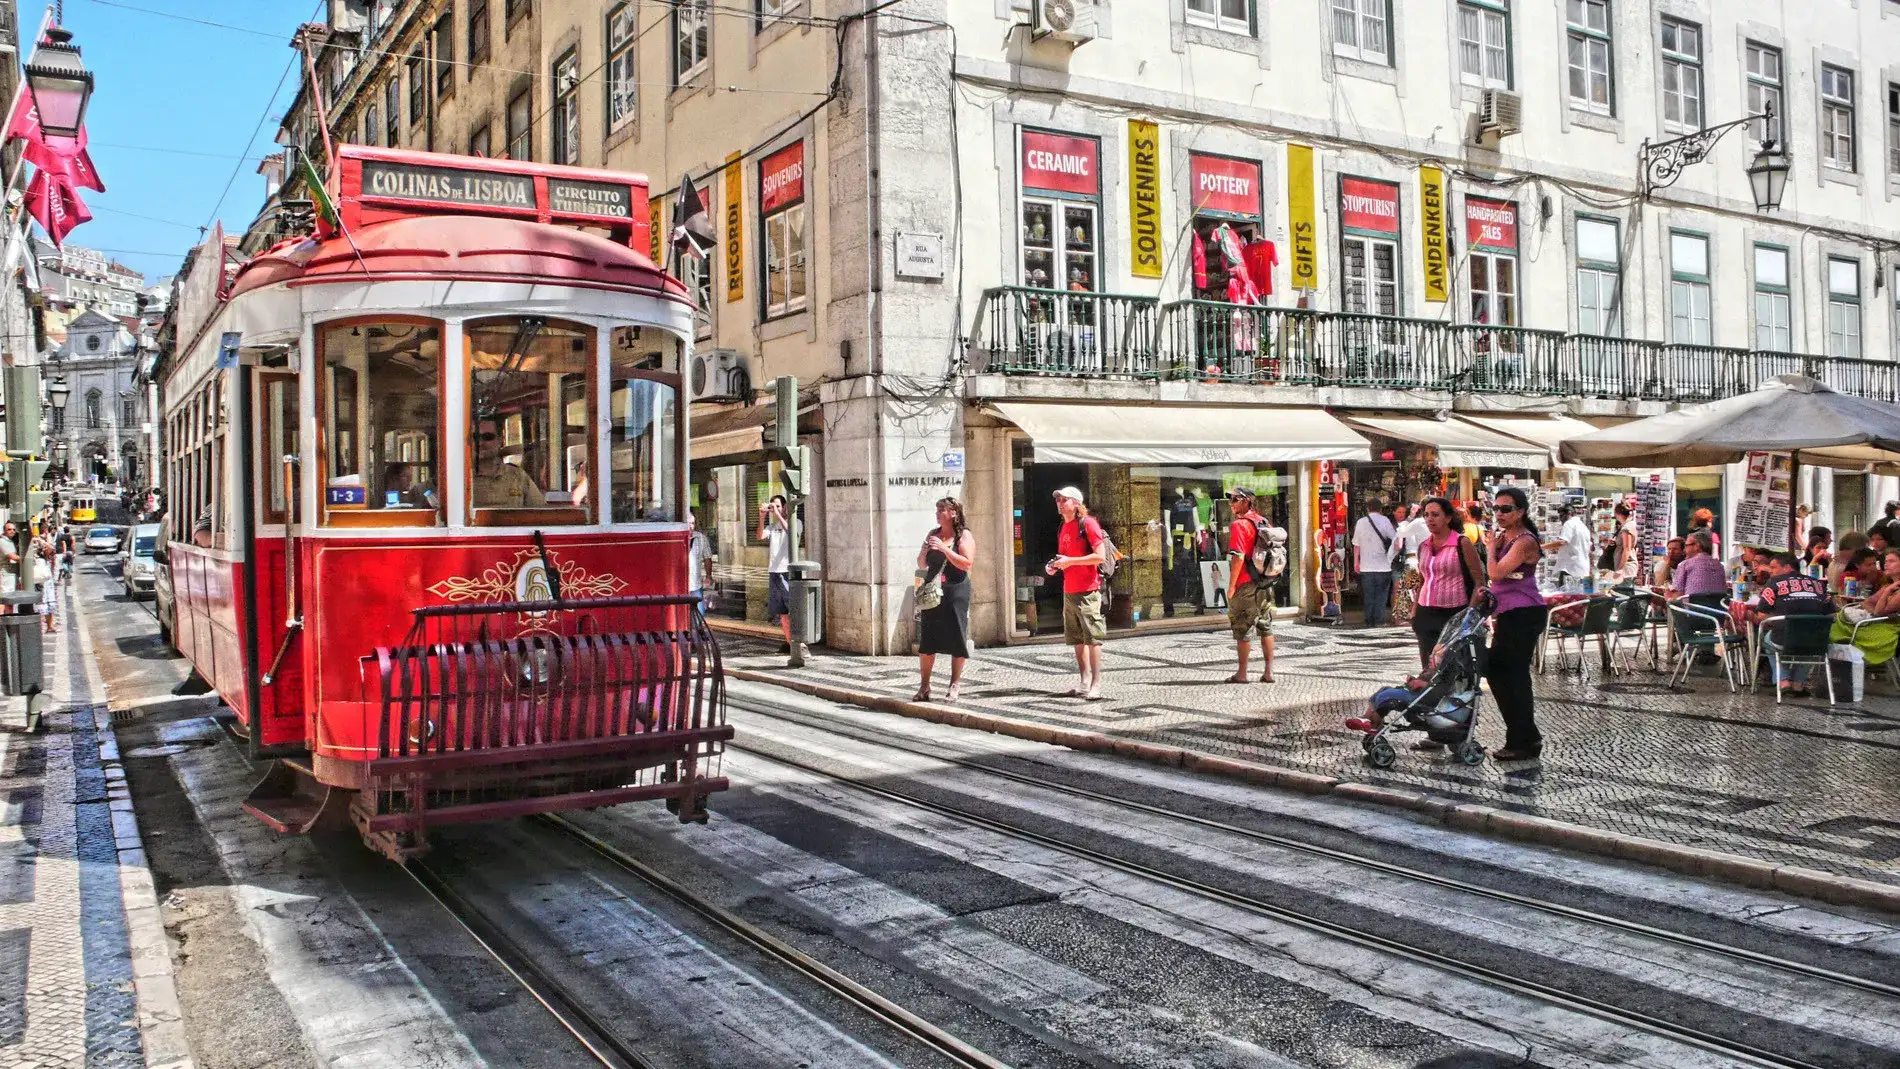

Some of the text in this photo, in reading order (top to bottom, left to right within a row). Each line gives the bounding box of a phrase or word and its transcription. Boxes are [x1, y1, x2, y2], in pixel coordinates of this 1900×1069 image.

[1027, 149, 1089, 176] CERAMIC
[372, 170, 451, 199] COLINAS
[464, 177, 528, 204] LISBOA
[763, 160, 803, 194] SOUVENIRS
[1200, 172, 1250, 196] POTTERY
[556, 186, 620, 203] CIRCUITO
[1134, 138, 1157, 266] SOUVENIRS
[1342, 193, 1396, 218] STOPTURIST
[554, 199, 627, 217] TURÍSTICO
[1467, 205, 1514, 225] HANDPAINTED
[1424, 183, 1444, 292] ANDENKEN
[1481, 224, 1502, 240] TILES
[728, 201, 740, 292] RICORDI
[915, 245, 928, 253] RUA
[1295, 221, 1314, 278] GIFTS
[907, 256, 934, 264] AUGUSTA
[888, 476, 919, 486] MARTINS
[920, 476, 927, 486] &
[332, 490, 354, 502] 1-3
